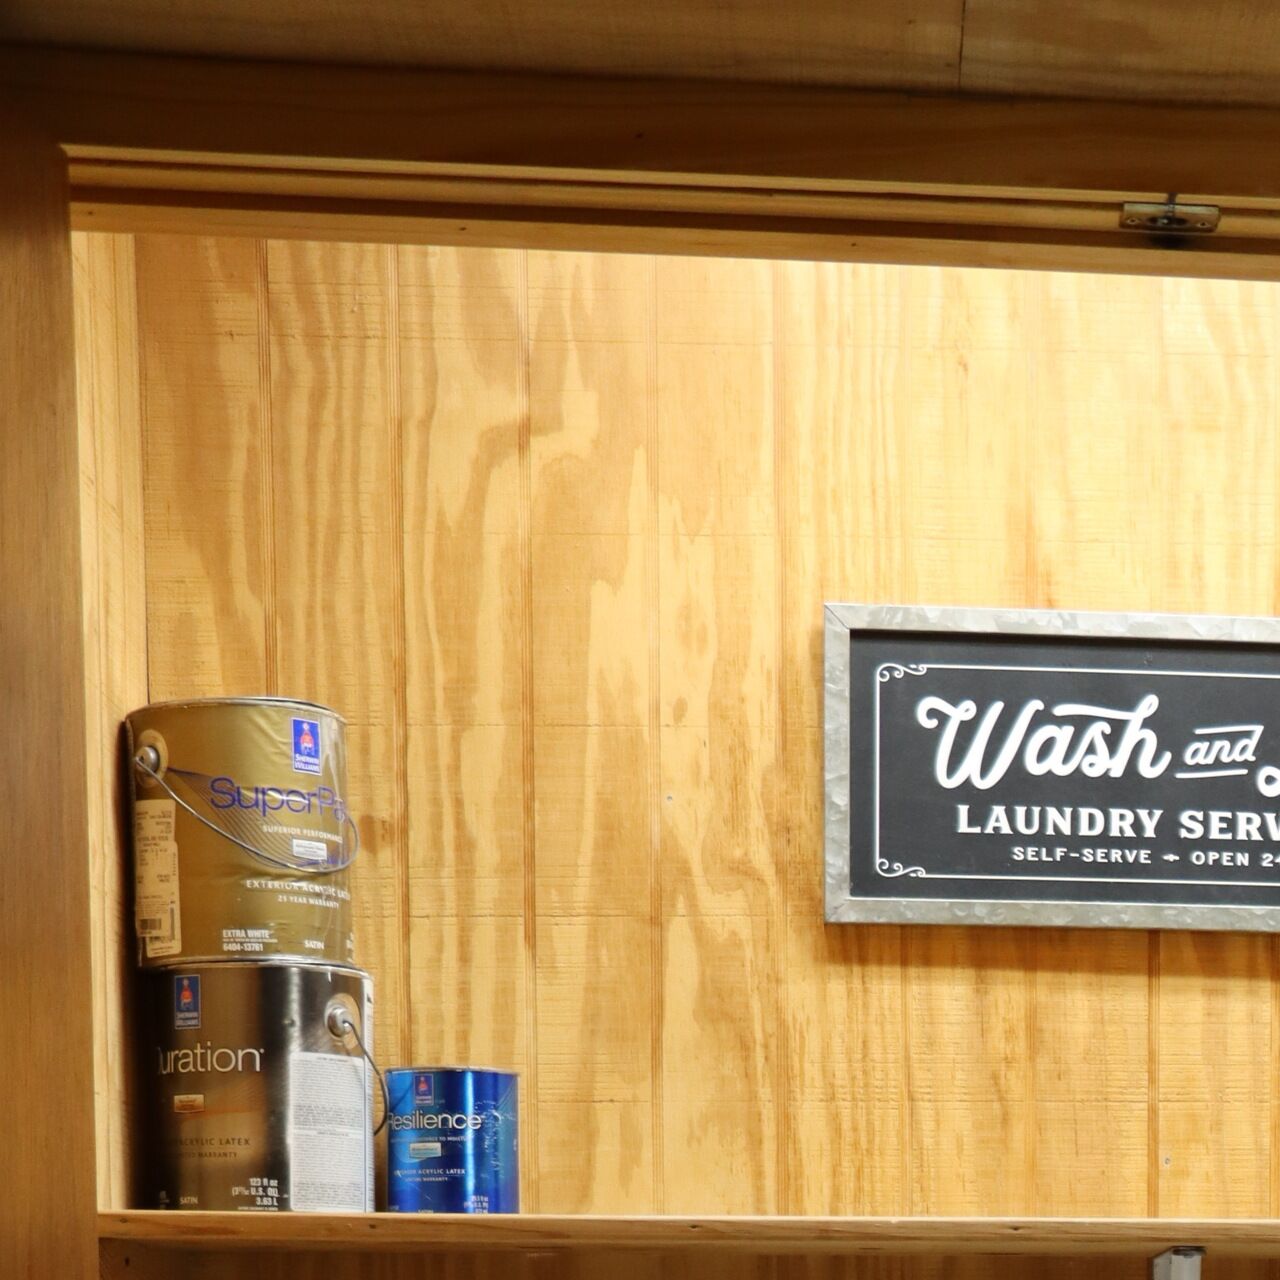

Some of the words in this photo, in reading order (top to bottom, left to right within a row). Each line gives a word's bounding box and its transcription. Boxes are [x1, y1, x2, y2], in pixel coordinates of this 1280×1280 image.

[916, 694, 1172, 790] Wash
[1183, 725, 1265, 767] and
[957, 804, 1164, 839] LAUNDRY
[1012, 847, 1152, 865] SELF-SERVE
[1191, 851, 1250, 868] OPEN
[158, 1041, 261, 1075] uration
[219, 1137, 251, 1146] LATEX
